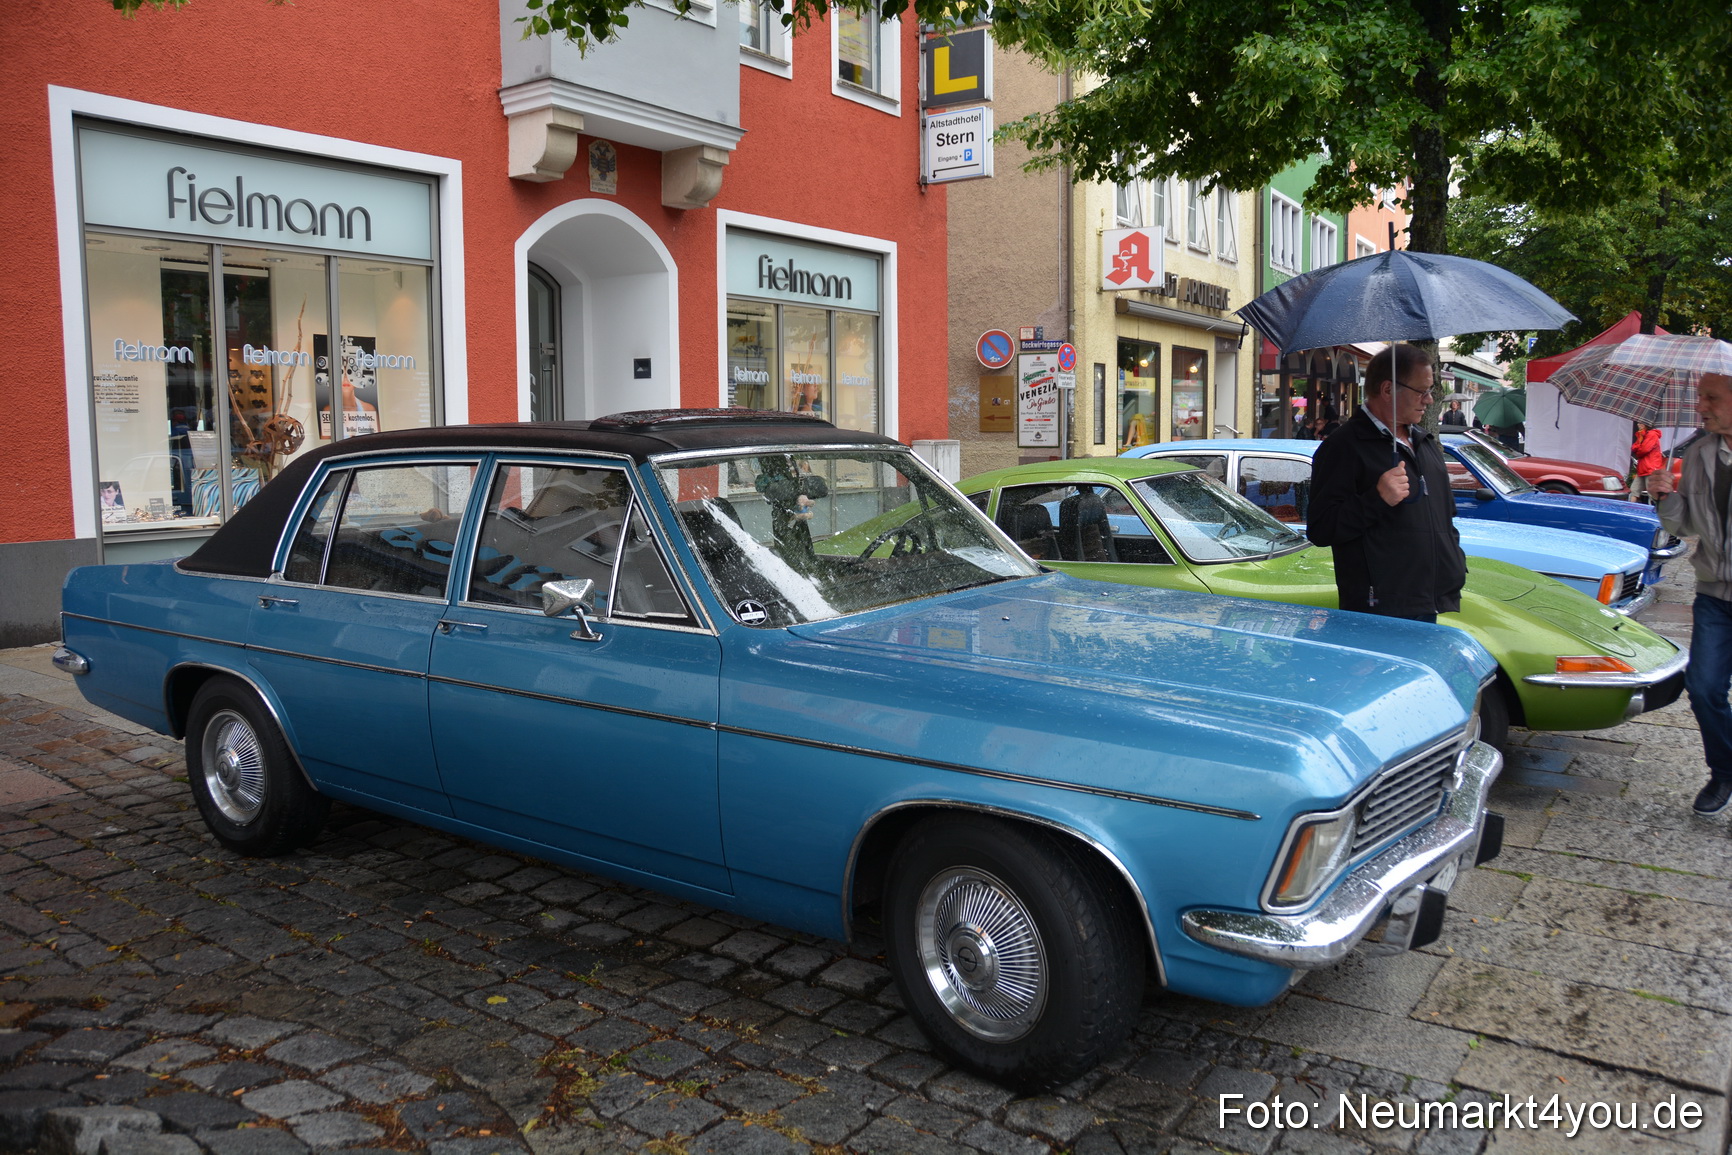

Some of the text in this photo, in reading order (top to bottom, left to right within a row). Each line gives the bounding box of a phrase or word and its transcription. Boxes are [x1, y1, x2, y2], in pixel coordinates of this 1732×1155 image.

[930, 113, 982, 129] Altstadthotel
[936, 131, 974, 147] Stern
[938, 154, 958, 163] Eingang
[167, 166, 371, 241] fielmann
[759, 254, 852, 300] fielmann
[1182, 277, 1231, 311] APOTHEKE
[114, 338, 194, 363] fielmann
[243, 343, 312, 366] fielmann
[356, 348, 416, 370] fielmann
[734, 366, 770, 383] fielmann
[1020, 382, 1058, 401] VENEZIA
[348, 413, 375, 422] kostenlos.
